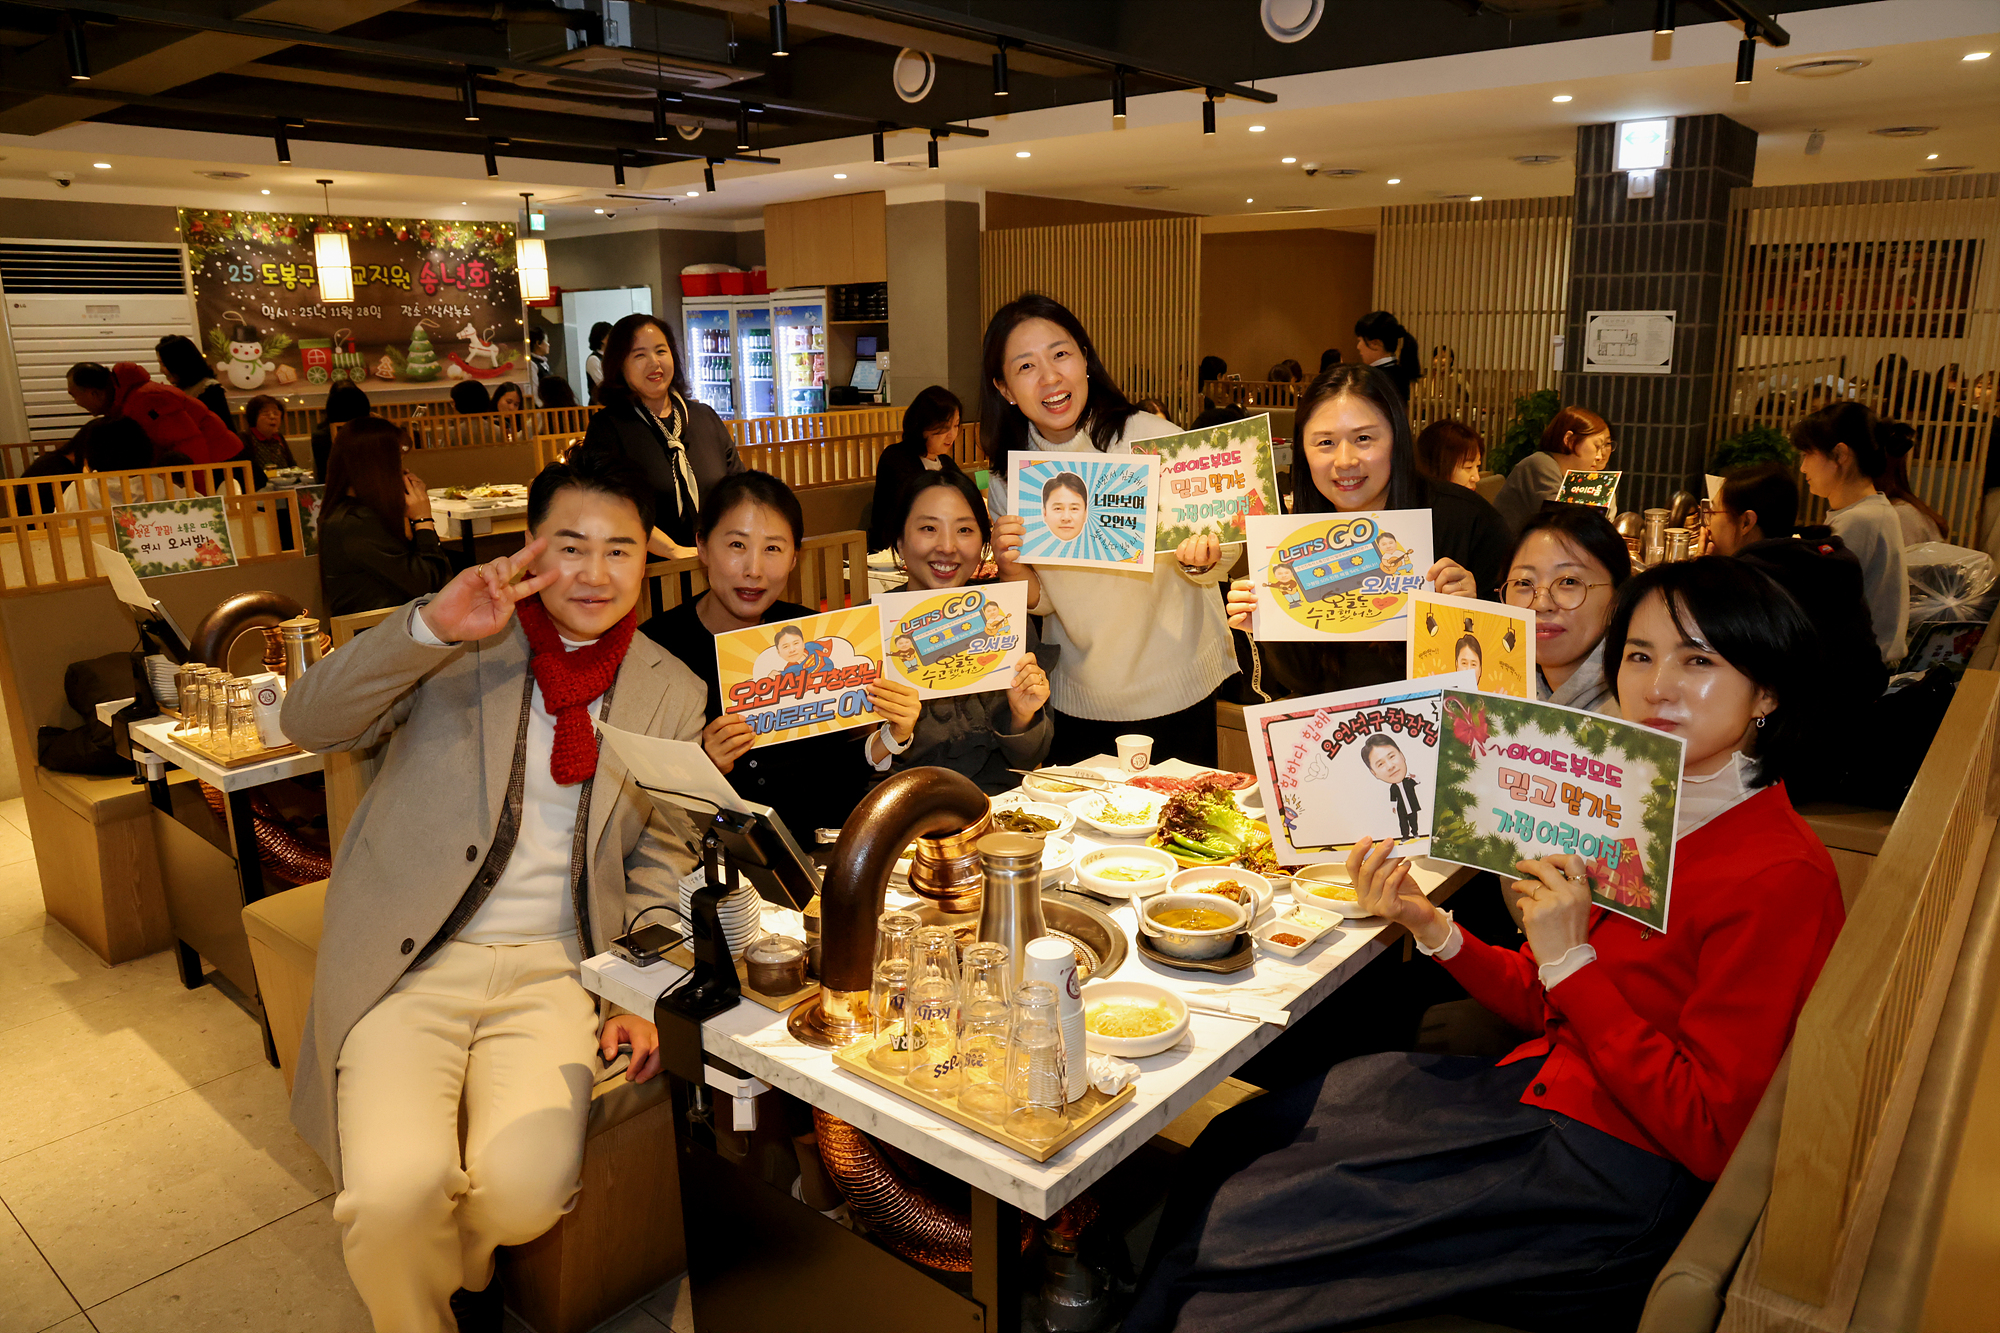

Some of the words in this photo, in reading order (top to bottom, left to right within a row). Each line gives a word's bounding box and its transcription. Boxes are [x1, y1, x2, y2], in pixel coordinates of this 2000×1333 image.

[229, 264, 254, 282] 25
[420, 259, 490, 295] 송년회
[262, 305, 288, 320] 일시
[300, 305, 327, 319] 25년
[330, 305, 353, 320] 11월
[356, 304, 382, 319] 28일
[400, 304, 422, 317] 장소
[1170, 476, 1209, 499] 믿고
[1209, 469, 1246, 494] 맡기는
[1094, 493, 1145, 510] 너만보여
[1098, 514, 1137, 530] 오언석
[140, 543, 161, 554] 역시
[168, 534, 210, 550] 오서방!
[1279, 537, 1326, 563] LET'S
[1326, 517, 1377, 551] GO
[1360, 575, 1424, 595] 오서방
[1321, 590, 1369, 609] 오늘도
[901, 609, 943, 634] LET'S
[942, 590, 986, 619] GO
[966, 634, 1019, 655] 오서방
[935, 653, 974, 669] 오늘도
[837, 689, 880, 719] ON
[1279, 743, 1309, 790] 힙하다
[1301, 710, 1333, 743] 힙해
[1506, 742, 1569, 773] 아이도
[1569, 752, 1624, 789] 부모도
[1497, 766, 1558, 809] 믿고
[1560, 781, 1622, 829] 맡기는
[914, 1004, 951, 1021] Kelly
